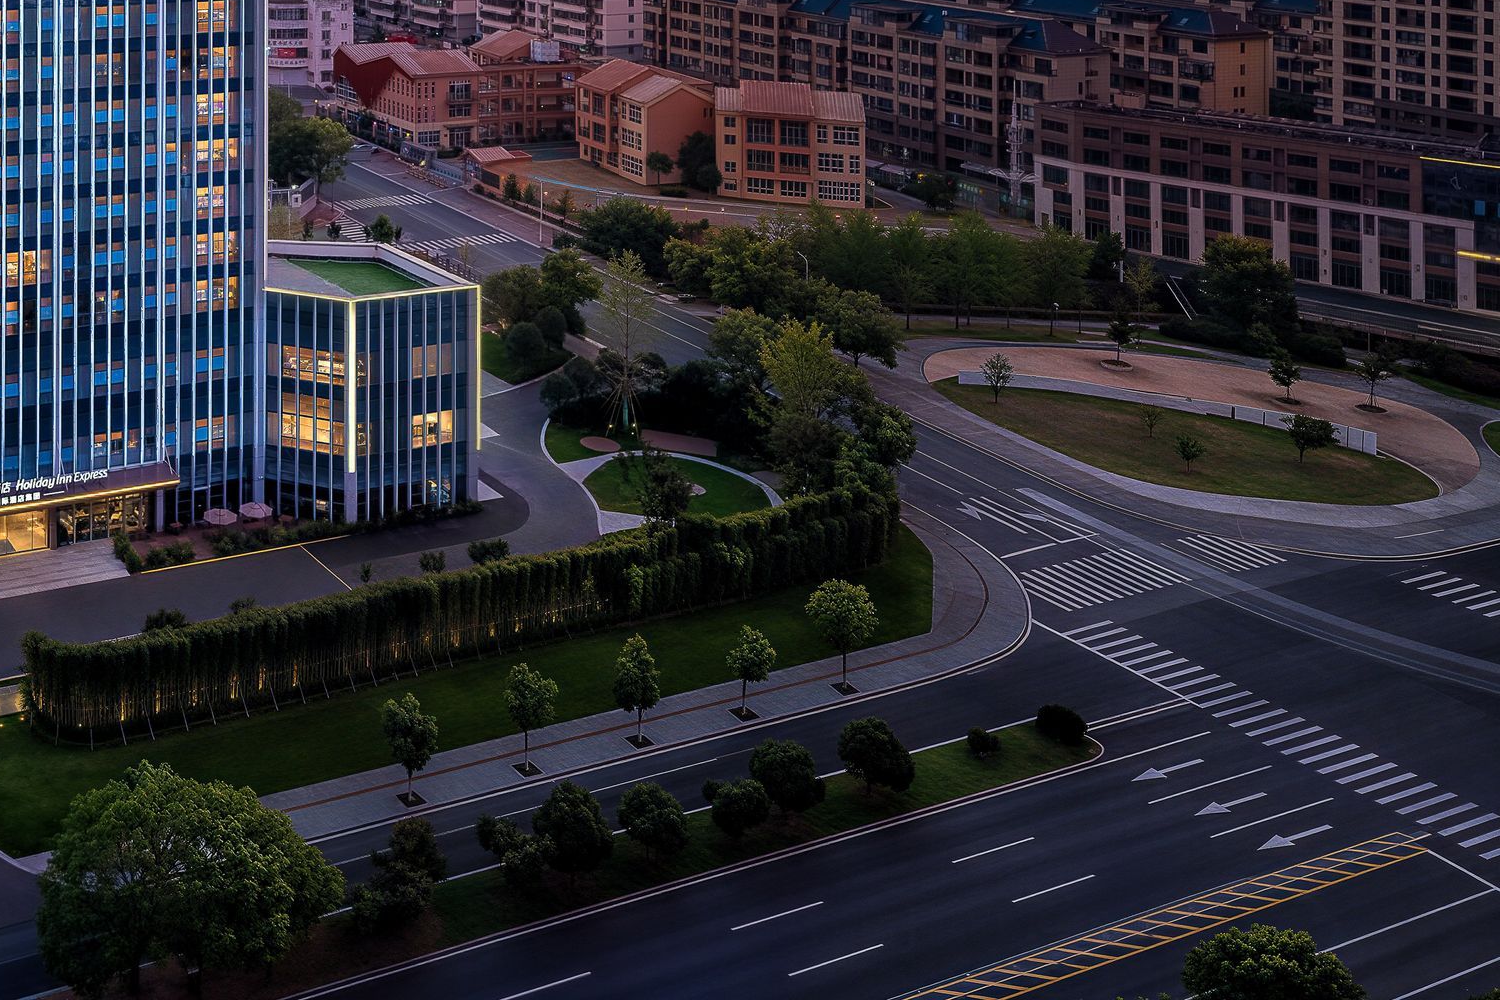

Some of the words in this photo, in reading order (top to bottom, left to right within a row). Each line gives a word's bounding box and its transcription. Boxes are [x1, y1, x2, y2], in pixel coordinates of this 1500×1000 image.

[16, 476, 55, 491] Holiday
[56, 473, 73, 485] Inn
[73, 468, 108, 484] Express
